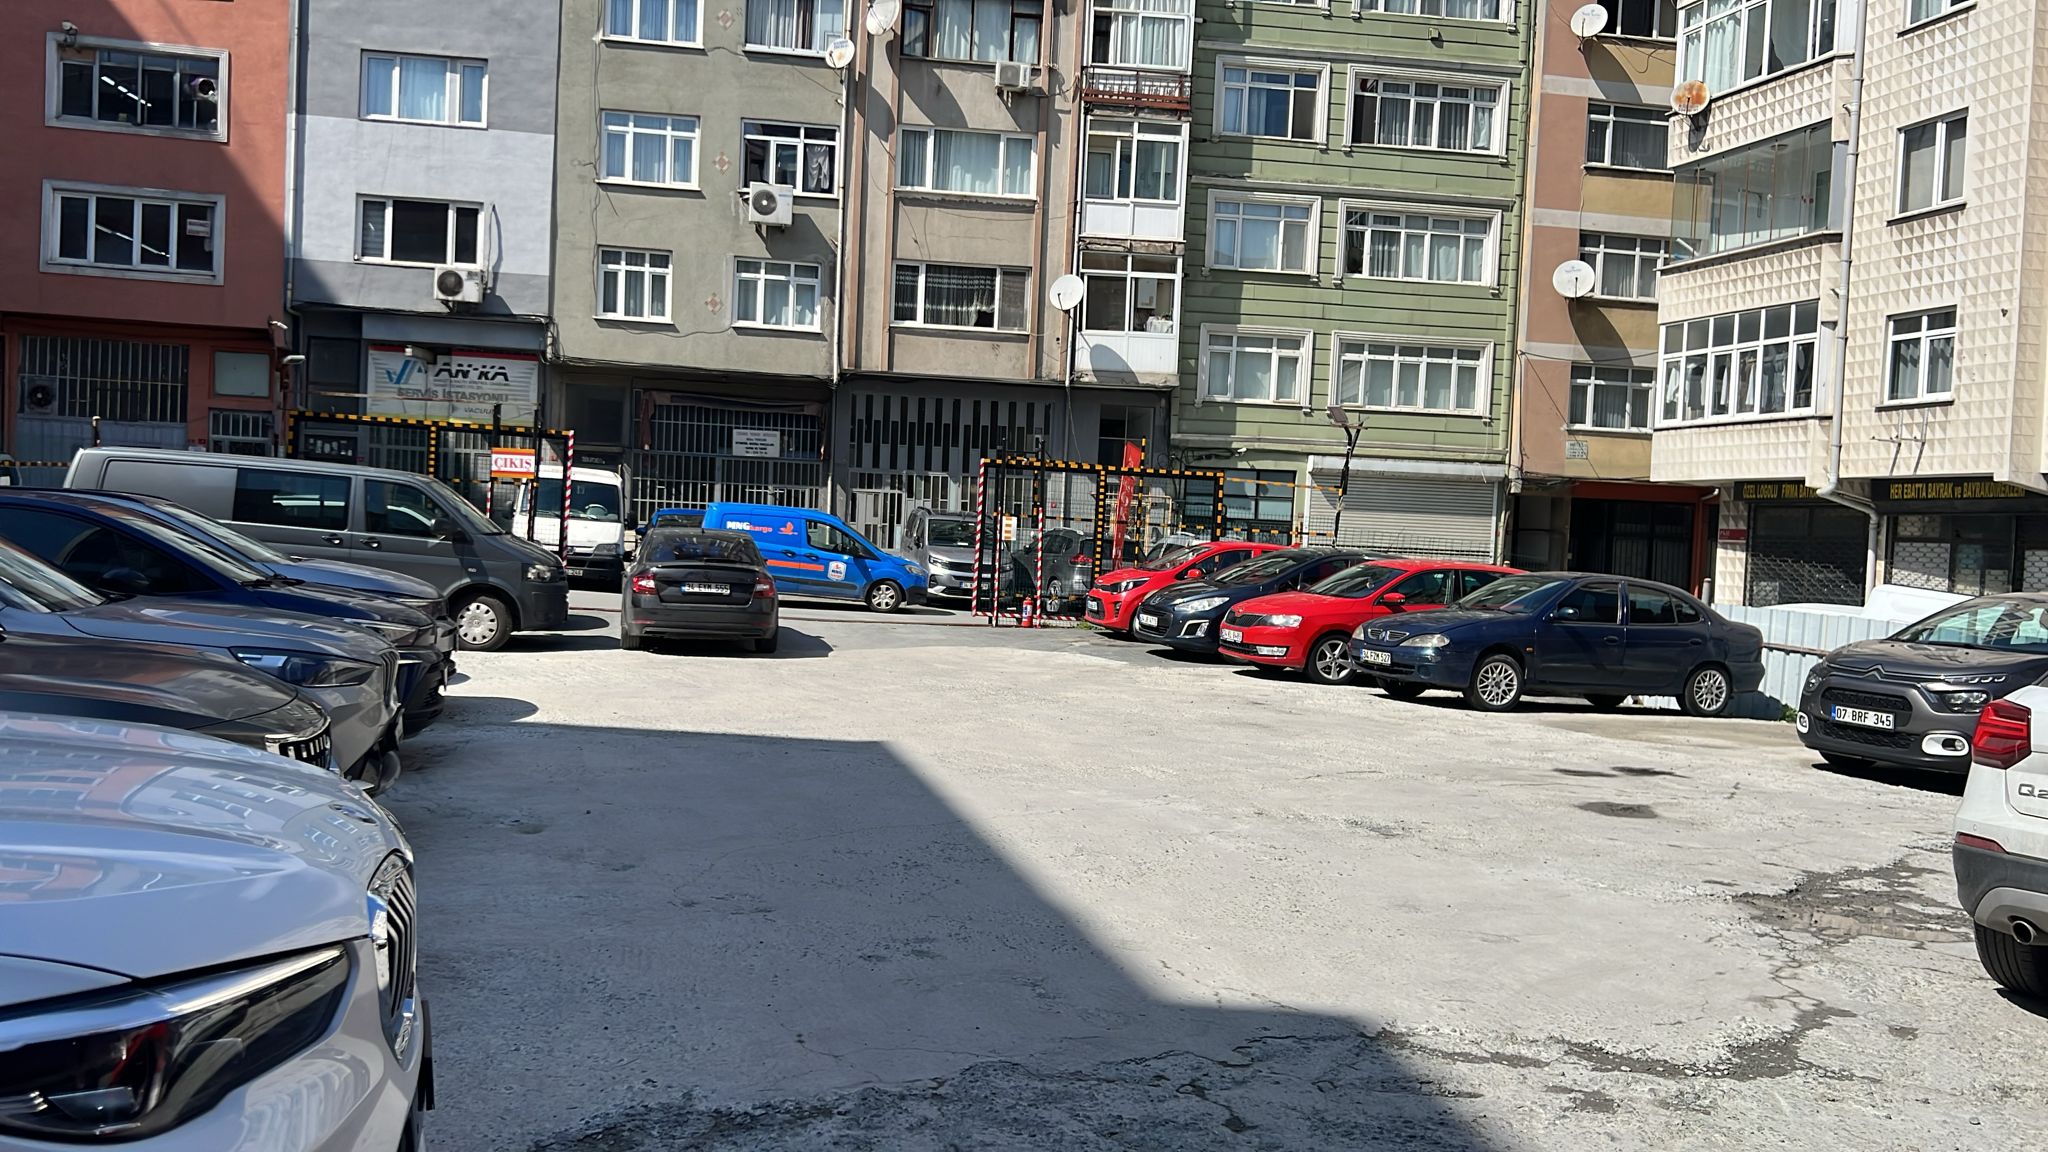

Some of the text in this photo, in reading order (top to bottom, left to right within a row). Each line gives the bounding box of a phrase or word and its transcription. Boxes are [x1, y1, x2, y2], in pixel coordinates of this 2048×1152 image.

[398, 386, 509, 403] SERVİS İSTASYONU
[464, 406, 495, 415] VACUU
[494, 456, 532, 473] ÇIKIŞ
[1890, 483, 1902, 499] HER
[1904, 483, 1926, 499] EBATTA
[1928, 483, 1953, 499] BAYRAK
[1955, 486, 1962, 498] ve
[1836, 707, 1892, 727] 07 BRF 345
